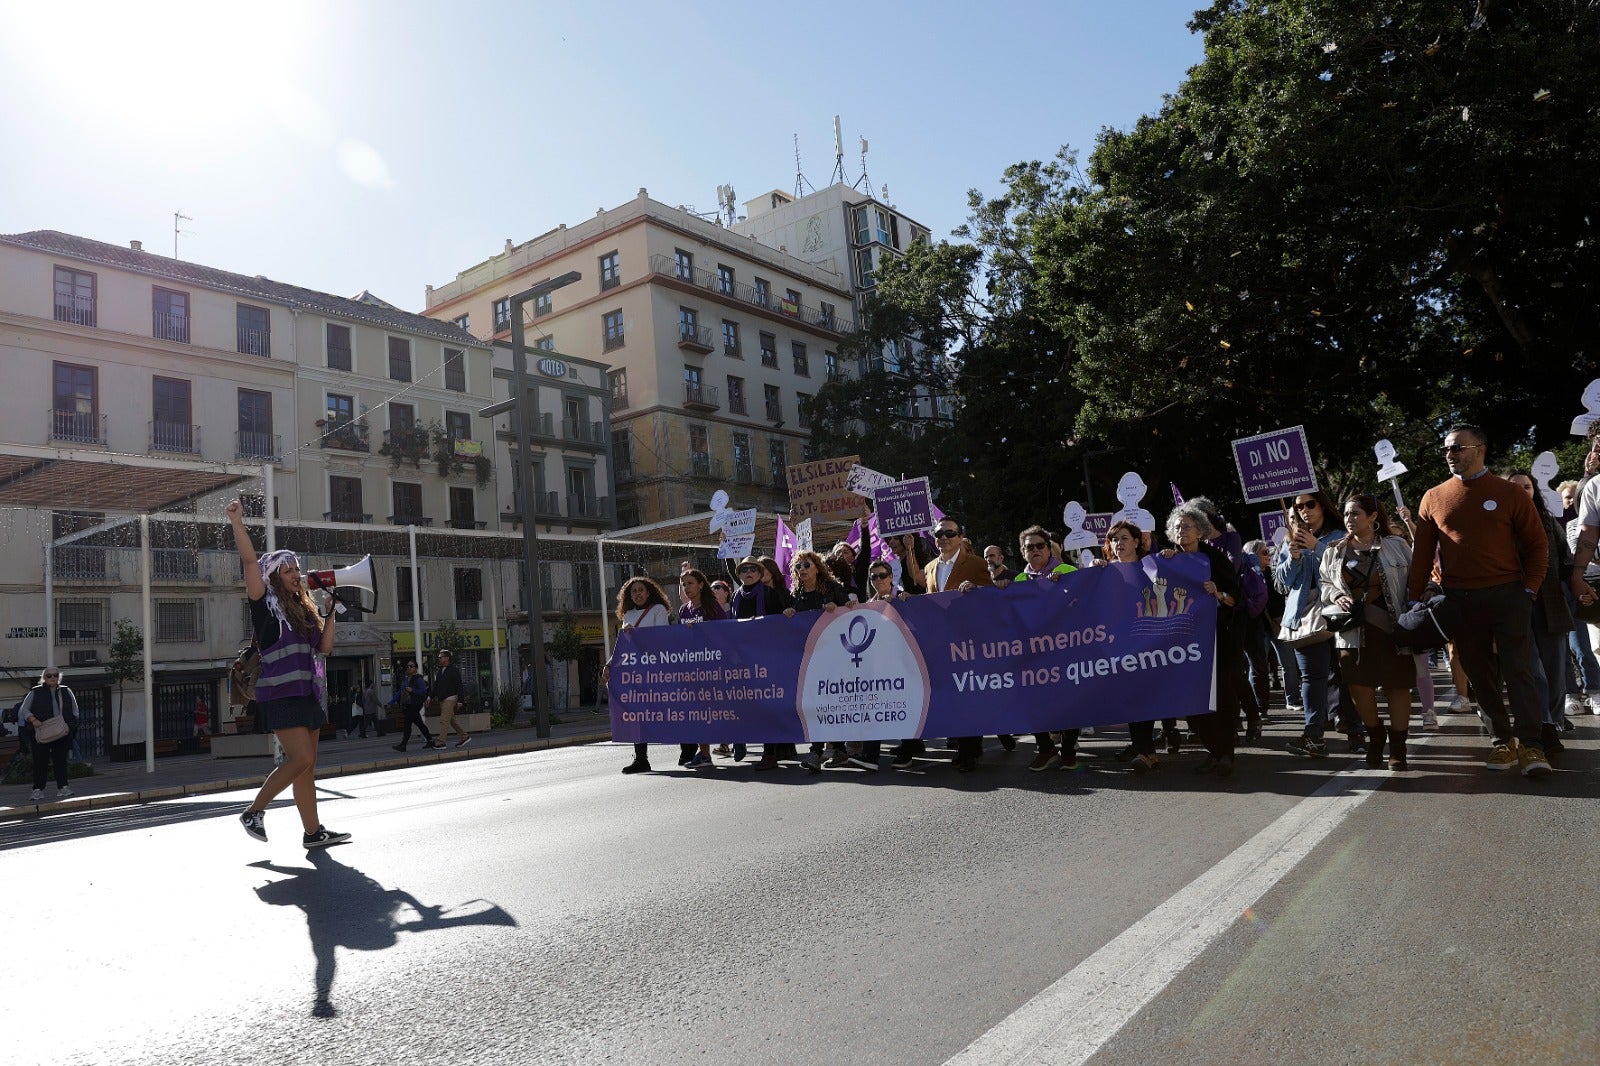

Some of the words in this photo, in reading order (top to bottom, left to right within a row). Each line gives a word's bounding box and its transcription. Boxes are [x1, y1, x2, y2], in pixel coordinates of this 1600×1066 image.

[541, 359, 564, 375] HOTEL
[1249, 449, 1262, 467] DI
[1265, 439, 1290, 463] NO
[790, 467, 808, 485] EL
[806, 460, 860, 480] SILENC
[1252, 473, 1258, 481] A
[1265, 466, 1299, 478] Violencia
[1247, 483, 1269, 492] contra
[1269, 481, 1280, 489] las
[1280, 475, 1310, 487] mujeres
[893, 499, 911, 515] ¡NO
[885, 518, 895, 530] TE
[895, 513, 926, 528] CALLES!
[1085, 521, 1093, 530] DI
[1094, 517, 1107, 529] NO
[1268, 519, 1276, 529] DI
[423, 632, 480, 649] Uniasa
[949, 639, 975, 662] Ni
[982, 639, 1023, 659] una
[1029, 624, 1115, 653] menos,
[621, 652, 637, 666] 25
[640, 652, 657, 665] de
[659, 647, 722, 664] Noviembre
[621, 670, 643, 685] Día
[646, 667, 722, 684] Internacional
[724, 667, 751, 685] para
[755, 663, 768, 679] la
[952, 670, 1015, 692] Vivas
[1021, 666, 1061, 686] nos
[1066, 643, 1202, 685] queremos
[620, 687, 696, 703] eliminación
[698, 687, 711, 701] de
[713, 687, 724, 701] la
[725, 684, 784, 701] violencia
[817, 676, 905, 695] Plataforma
[838, 693, 864, 703] contra
[865, 692, 879, 701] las
[815, 703, 858, 713] violencias
[859, 700, 907, 711] machistas
[622, 709, 664, 722] contra
[667, 708, 685, 722] las
[688, 707, 740, 725] mujeres.
[816, 712, 871, 725] VIOLENCIA
[874, 710, 907, 722] CERO
